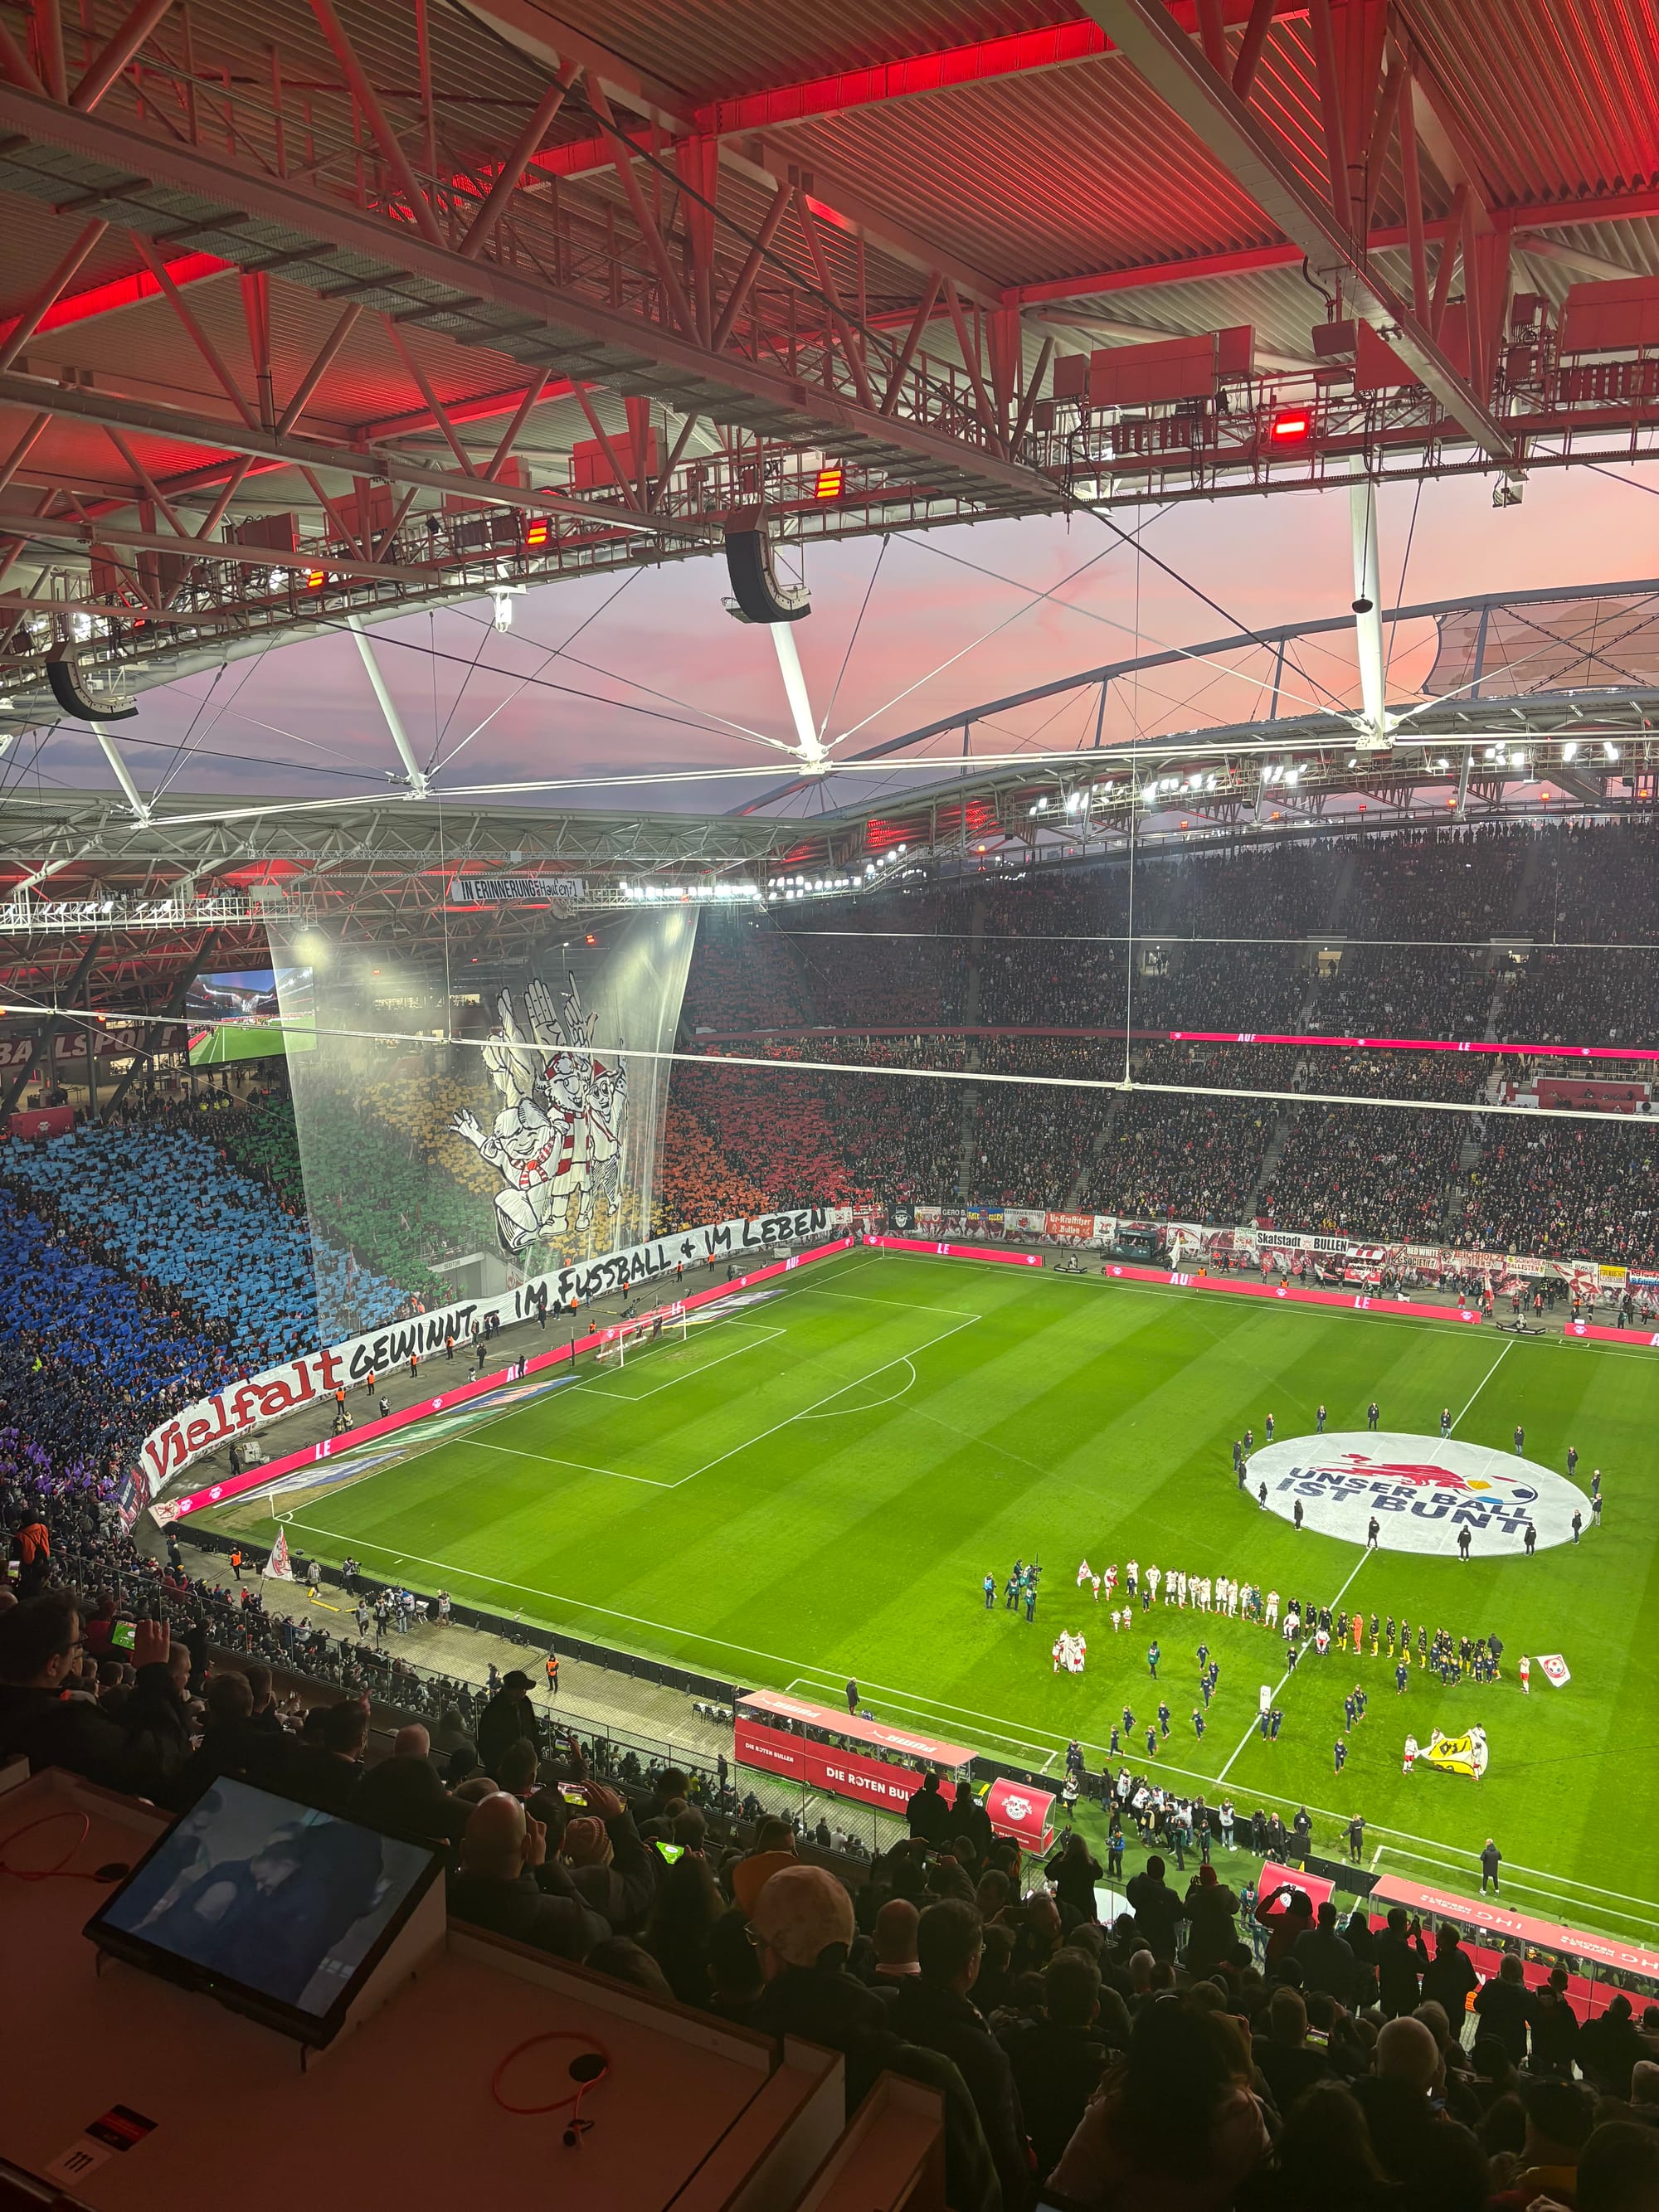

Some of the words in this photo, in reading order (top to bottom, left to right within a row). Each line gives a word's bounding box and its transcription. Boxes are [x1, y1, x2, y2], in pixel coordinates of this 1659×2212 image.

[461, 881, 474, 900] IN
[475, 879, 537, 898] ERINNERUNG
[1238, 1033, 1257, 1042] AUF
[1458, 1042, 1471, 1051] LE
[1059, 1225, 1080, 1235] Bullen
[937, 1242, 951, 1255] LE
[1257, 1232, 1301, 1247] Skatstadt
[1313, 1237, 1347, 1252] BULLEN
[1407, 1246, 1418, 1255] RED
[1418, 1247, 1439, 1257] WHITE
[786, 1255, 800, 1271] AUF
[1354, 1296, 1371, 1310] LE
[145, 1349, 343, 1478] Vielfalt
[350, 1304, 478, 1379] GEWINNT
[515, 1280, 547, 1319] IM
[557, 1243, 672, 1304] FUSSBALL
[704, 1225, 731, 1256] IM
[742, 1208, 828, 1249] LEBEN
[314, 1439, 331, 1458] LE
[1289, 1467, 1417, 1499] UNSER
[1431, 1492, 1534, 1520] BALL
[1275, 1478, 1363, 1501] IST
[1371, 1495, 1531, 1534] BUNT
[772, 1700, 822, 1719] PUMA
[885, 1734, 938, 1753] PUMA
[774, 1751, 794, 1763] BULLEN
[826, 1767, 845, 1782] DIE
[888, 1786, 914, 1803] BUL
[1475, 1911, 1522, 1930] IHG
